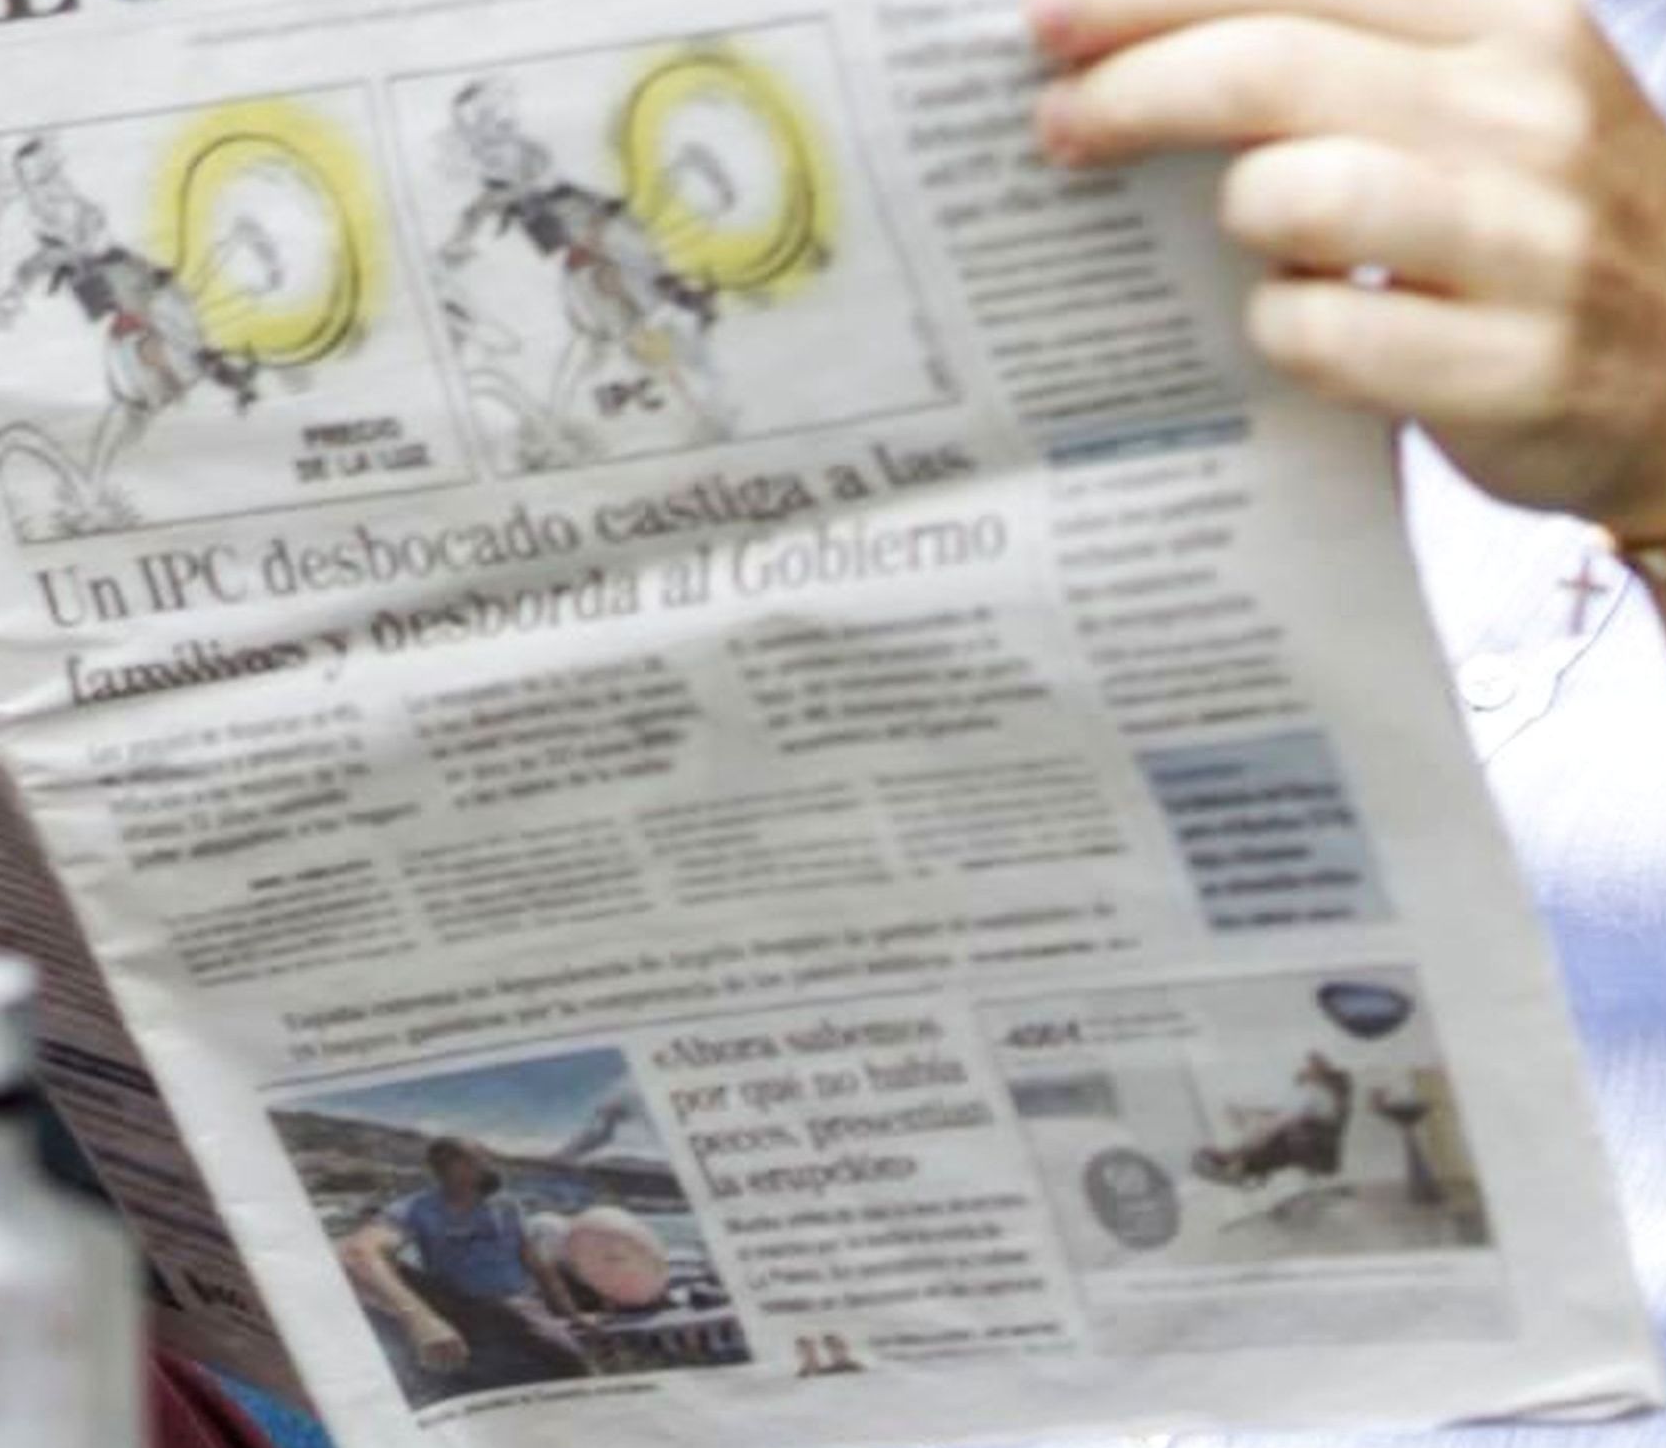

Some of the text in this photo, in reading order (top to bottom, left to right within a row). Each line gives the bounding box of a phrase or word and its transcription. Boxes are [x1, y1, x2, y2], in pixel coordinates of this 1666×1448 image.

[37, 442, 978, 628] Un IPC desbocado castiga a las
[370, 567, 637, 652] desborda
[664, 543, 710, 608] al
[734, 512, 1009, 597] Gobierno
